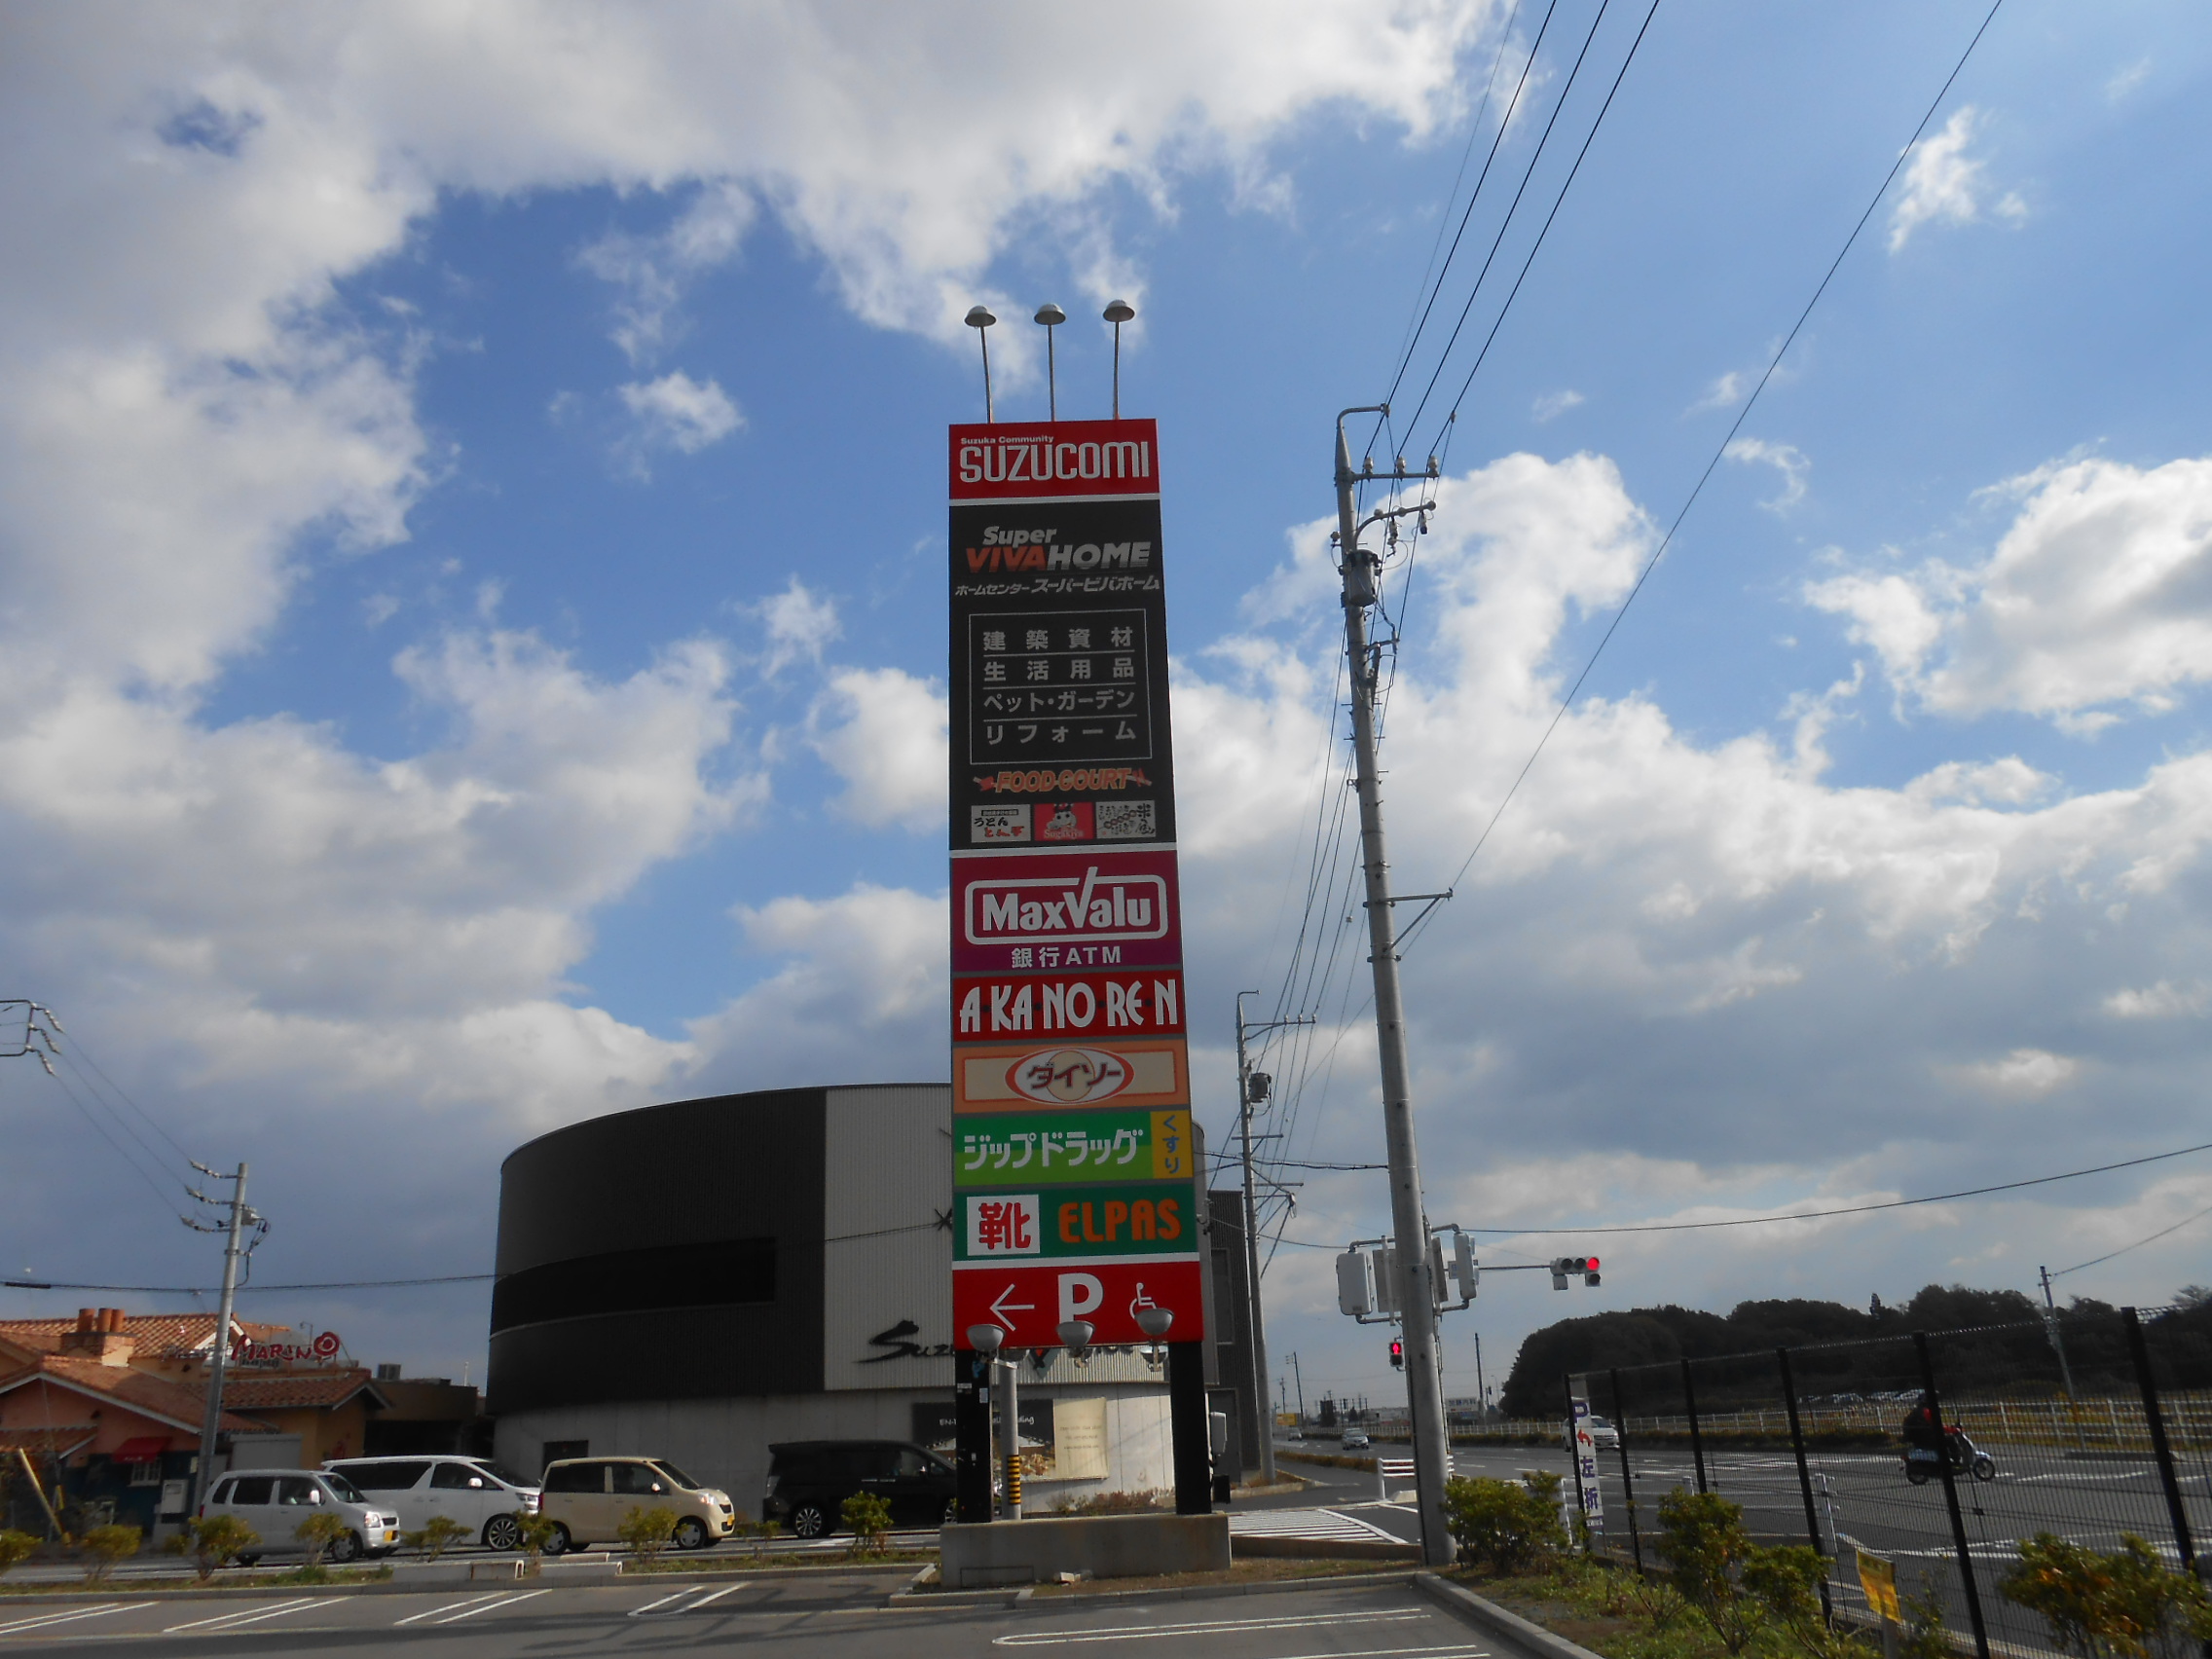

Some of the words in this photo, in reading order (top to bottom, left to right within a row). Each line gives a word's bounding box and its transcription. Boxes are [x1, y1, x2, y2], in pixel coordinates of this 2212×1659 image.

[961, 436, 996, 445] Suzuka
[999, 434, 1054, 444] Community
[982, 526, 1057, 548] Super
[954, 583, 1030, 597] ホームセンター
[1031, 574, 1161, 595] スーパービバホーム
[982, 626, 1133, 651] 建築資材
[983, 657, 1134, 682] 生活用品
[983, 688, 1135, 713] ペット・ガーデン
[986, 720, 1137, 746] リフォーム
[995, 769, 1054, 793] FOOD
[1055, 767, 1133, 792] COURT
[974, 816, 1009, 828] うどん
[982, 866, 1152, 932] MaxValu
[1011, 945, 1122, 969] 銀行ATM
[1026, 1060, 1123, 1090] ダイソー
[964, 1128, 1144, 1170] ジップドラッグ
[1162, 1115, 1181, 1174] くすり
[978, 1201, 1032, 1250] 靴
[1057, 1198, 1182, 1243] ELPAS
[1057, 1272, 1104, 1325] P
[1572, 1401, 1589, 1424] P
[1580, 1456, 1599, 1510] 左折
